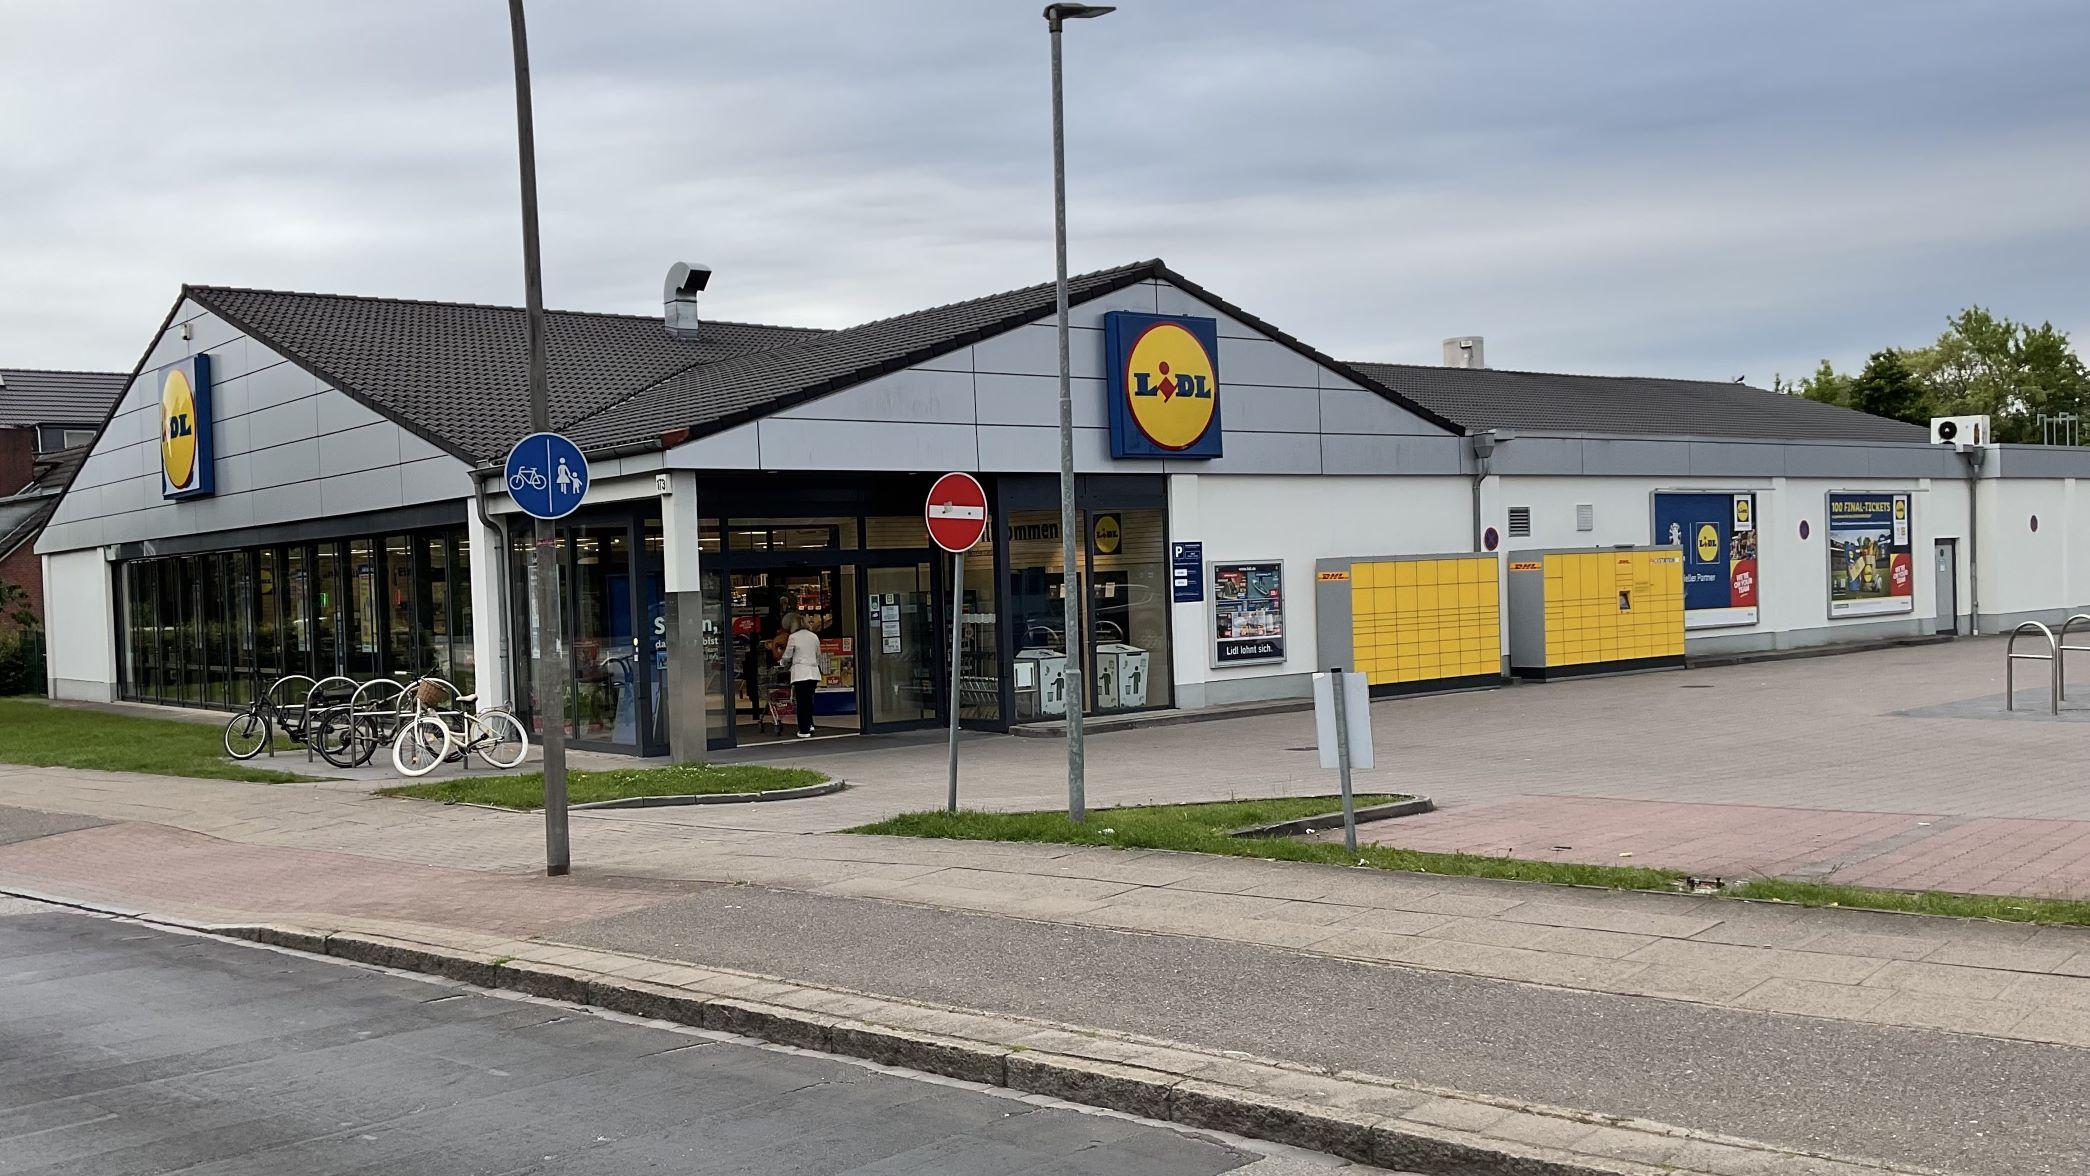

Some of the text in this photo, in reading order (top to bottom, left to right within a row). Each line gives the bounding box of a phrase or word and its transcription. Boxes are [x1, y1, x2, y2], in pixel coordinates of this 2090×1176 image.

[656, 478, 666, 490] 173
[1831, 502, 1843, 513] 100
[1843, 501, 1891, 513] FINAL-TICKETS
[1175, 545, 1183, 558] P
[1226, 645, 1239, 656] Lidl
[1240, 645, 1257, 655] lohnt
